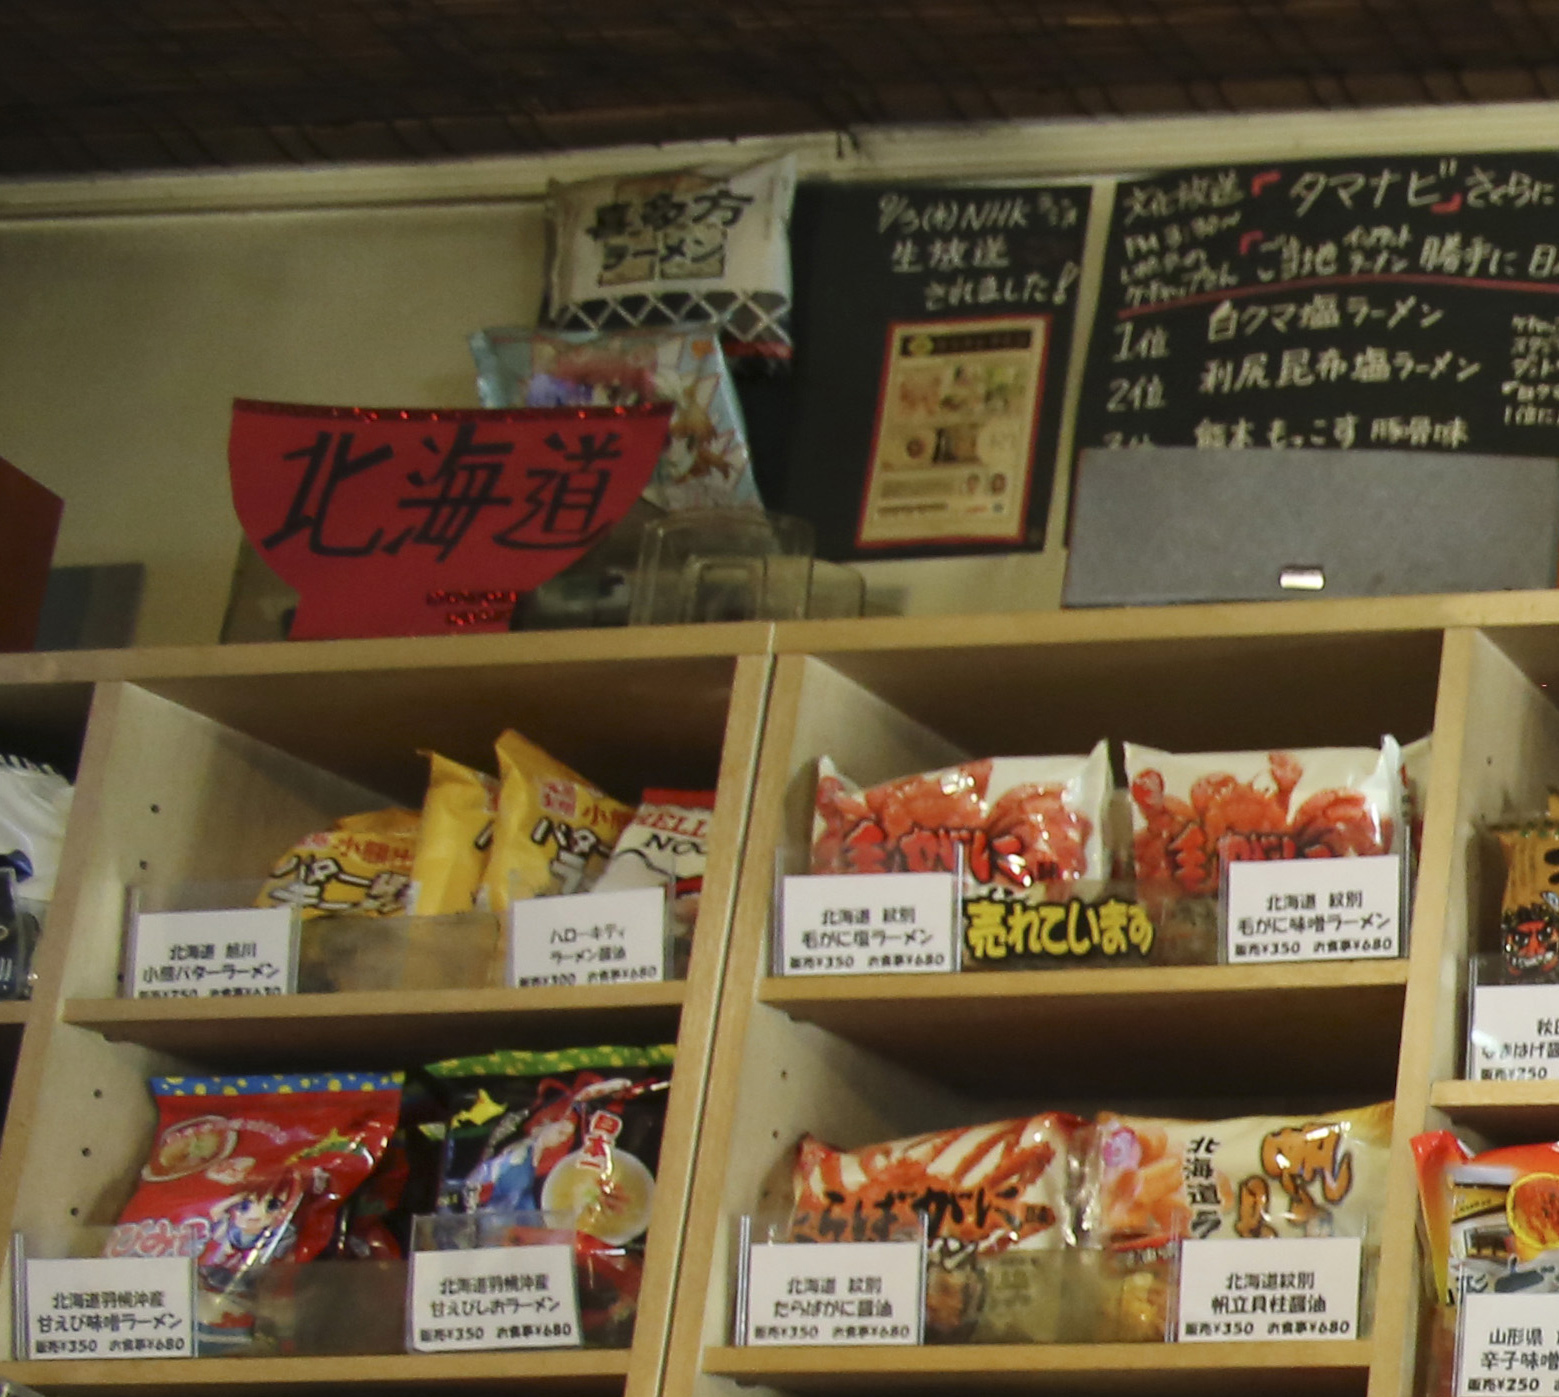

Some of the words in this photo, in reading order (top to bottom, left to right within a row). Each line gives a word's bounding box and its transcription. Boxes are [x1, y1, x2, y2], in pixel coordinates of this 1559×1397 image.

[263, 422, 623, 563] 北海道
[1265, 893, 1316, 912] 北海道
[1328, 891, 1363, 910] 紋別
[822, 908, 871, 927] 北海道
[882, 907, 916, 925] 紋別
[1238, 912, 1392, 936] 毛がに味噌ラーメン
[549, 925, 627, 945] ハローキティ
[801, 927, 935, 949] 毛がに塩ラーメン
[169, 943, 215, 962] 北海道
[549, 946, 628, 965] ラーメン醤油
[142, 964, 281, 983] 小熊バターラーメン
[787, 1276, 838, 1295] 北海道
[848, 1276, 882, 1294] 紋別
[1226, 1271, 1316, 1291] 北海道紋別
[430, 1295, 561, 1317] 甘えびしおラーメン
[773, 1297, 893, 1318] たらばがに醤油
[1212, 1293, 1328, 1315] 帆立貝柱醤油
[37, 1312, 182, 1332] 甘えび味噌ラーメン
[1489, 1327, 1543, 1346] 山形県
